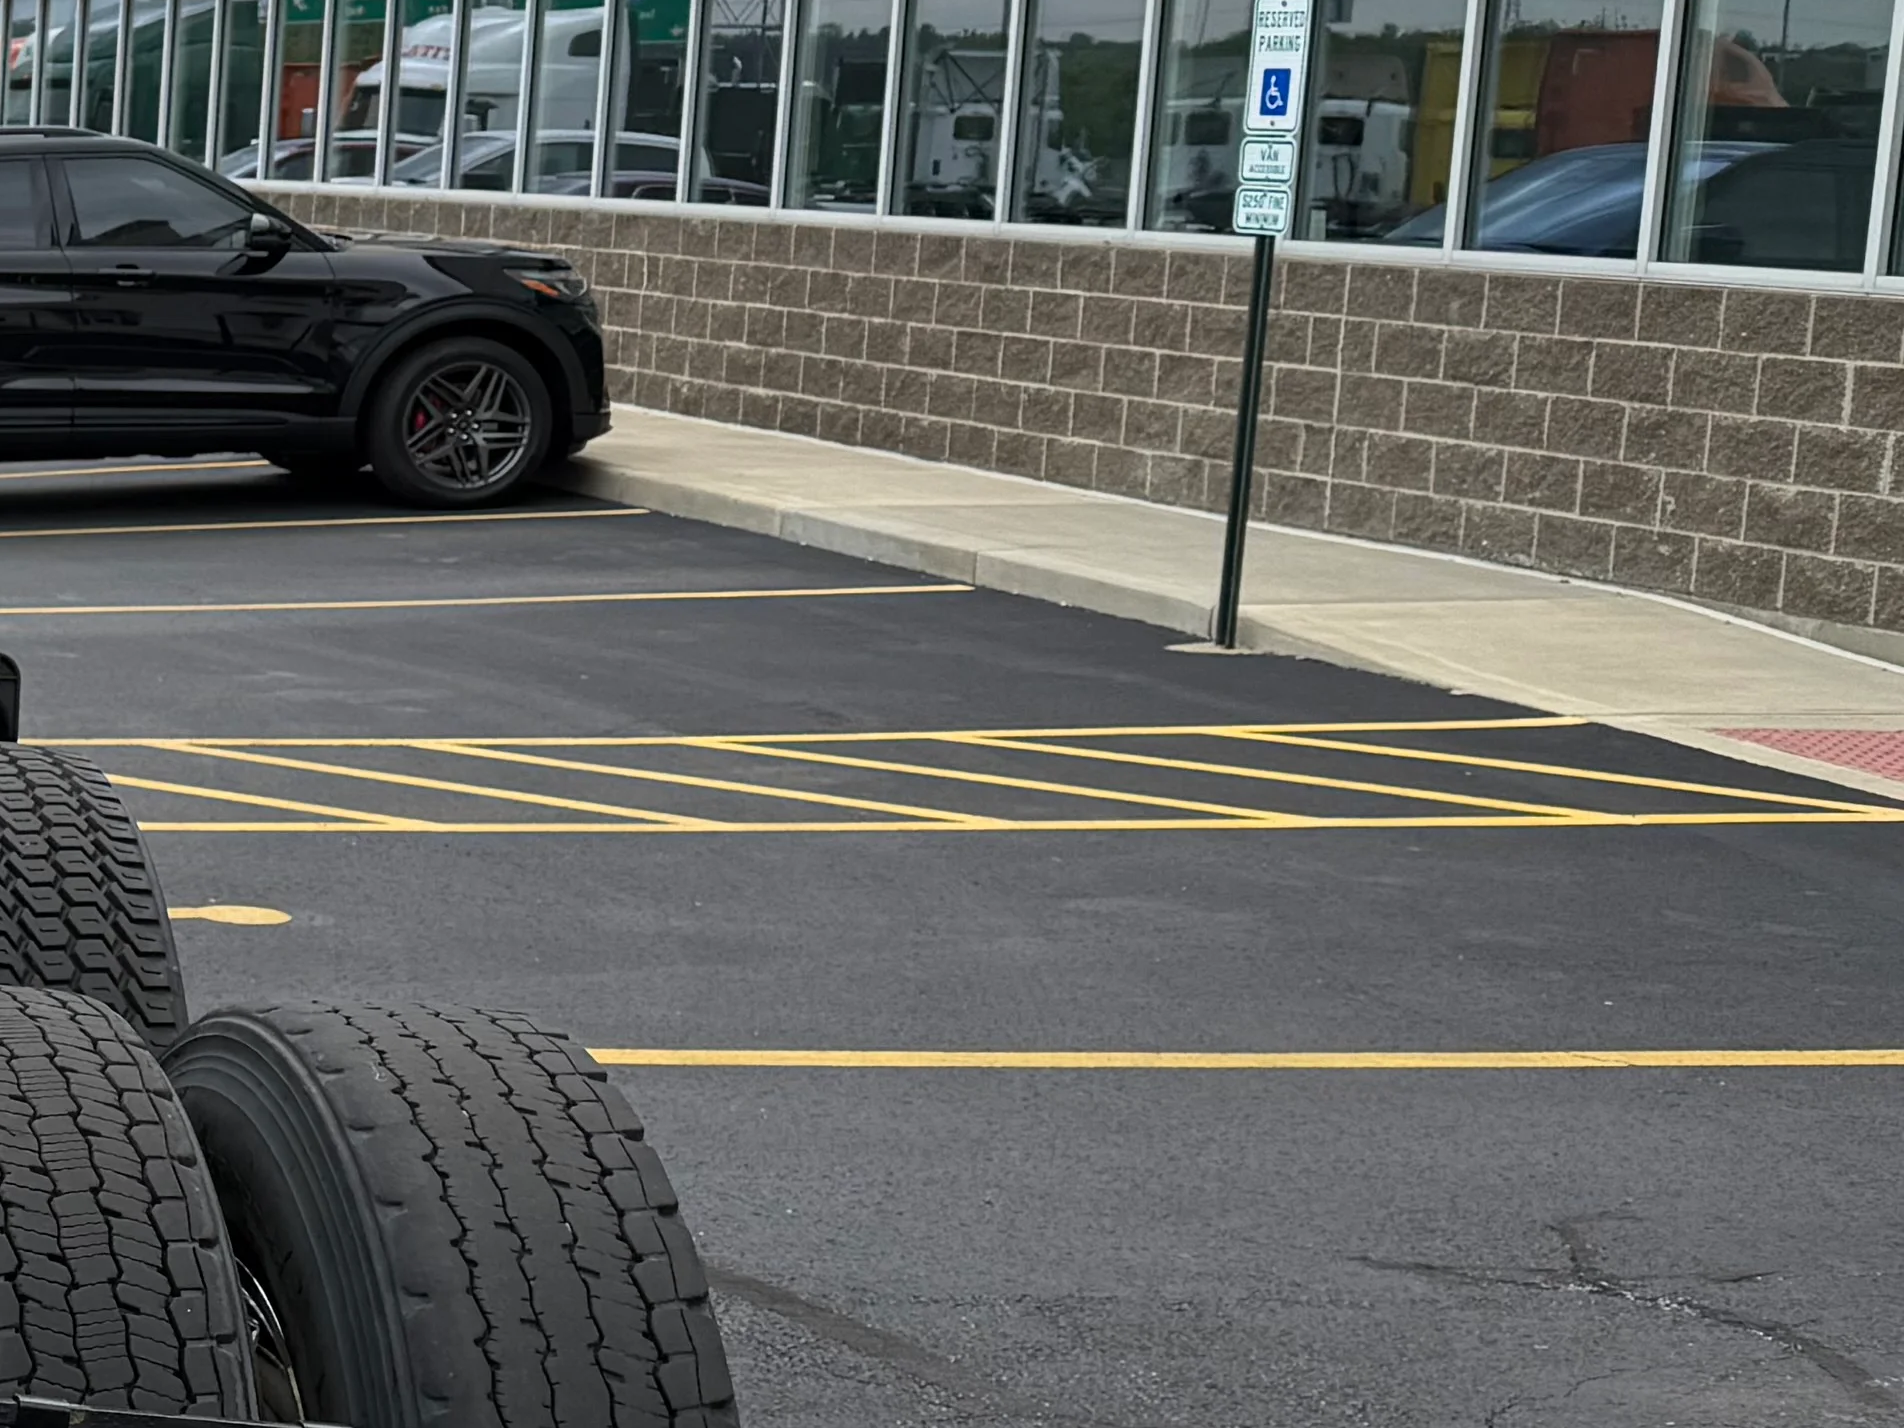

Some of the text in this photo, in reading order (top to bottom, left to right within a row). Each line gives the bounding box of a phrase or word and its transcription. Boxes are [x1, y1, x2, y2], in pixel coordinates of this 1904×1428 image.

[1258, 10, 1305, 28] RESERVED
[1259, 35, 1301, 52] PARKING
[1261, 148, 1280, 162] VAN
[1268, 195, 1285, 210] FINE
